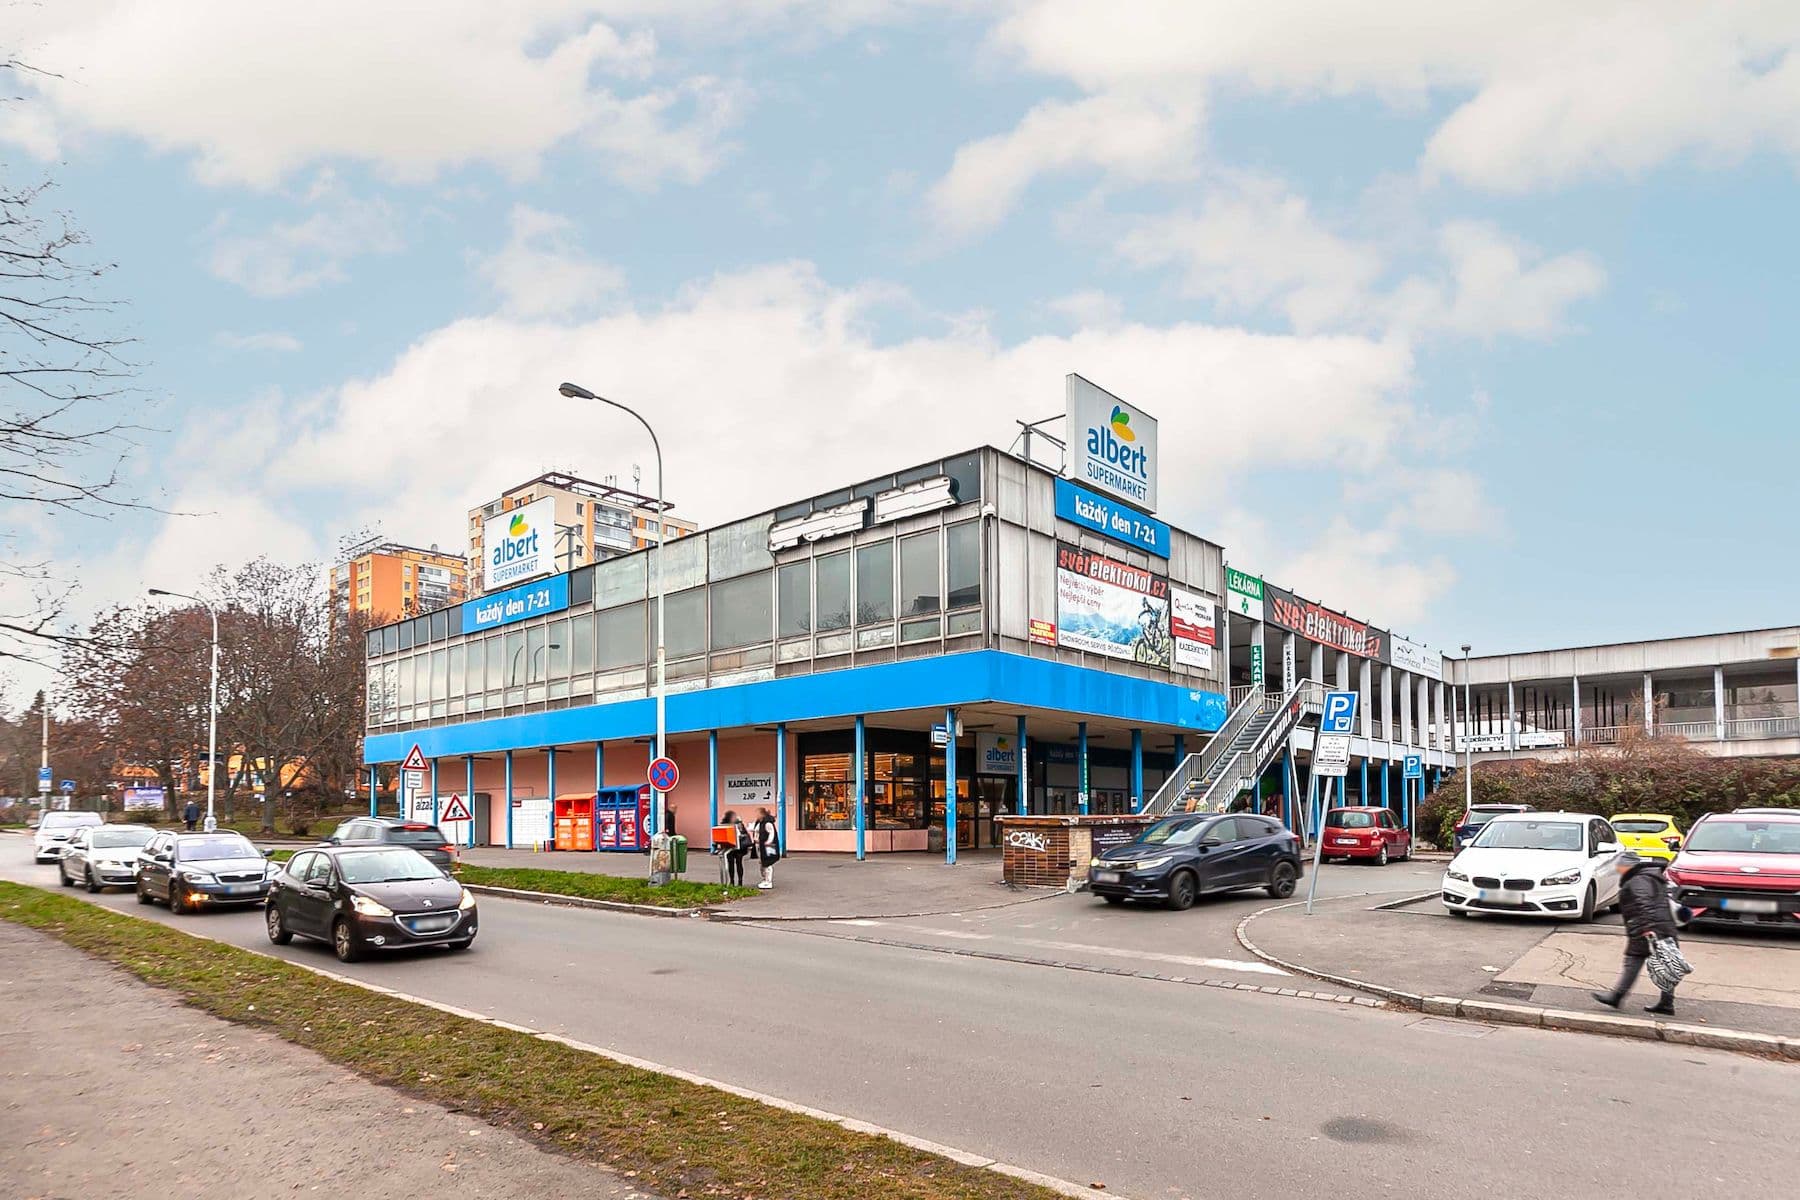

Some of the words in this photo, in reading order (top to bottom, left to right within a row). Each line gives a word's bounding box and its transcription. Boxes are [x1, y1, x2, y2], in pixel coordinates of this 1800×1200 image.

[1087, 425, 1147, 479] albert
[1087, 462, 1147, 501] SUPERMARKET
[1075, 495, 1108, 530] každý
[1111, 512, 1131, 534] den
[1133, 521, 1156, 545] 7-21
[493, 528, 538, 565] albert
[493, 560, 538, 583] SUPERMARKET
[1229, 570, 1261, 598] LÉKÁRNA
[476, 601, 504, 625] každý
[506, 598, 524, 617] den
[527, 590, 550, 611] 7-21
[1328, 696, 1350, 721] P
[986, 747, 1015, 762] albert
[1407, 757, 1418, 772] P
